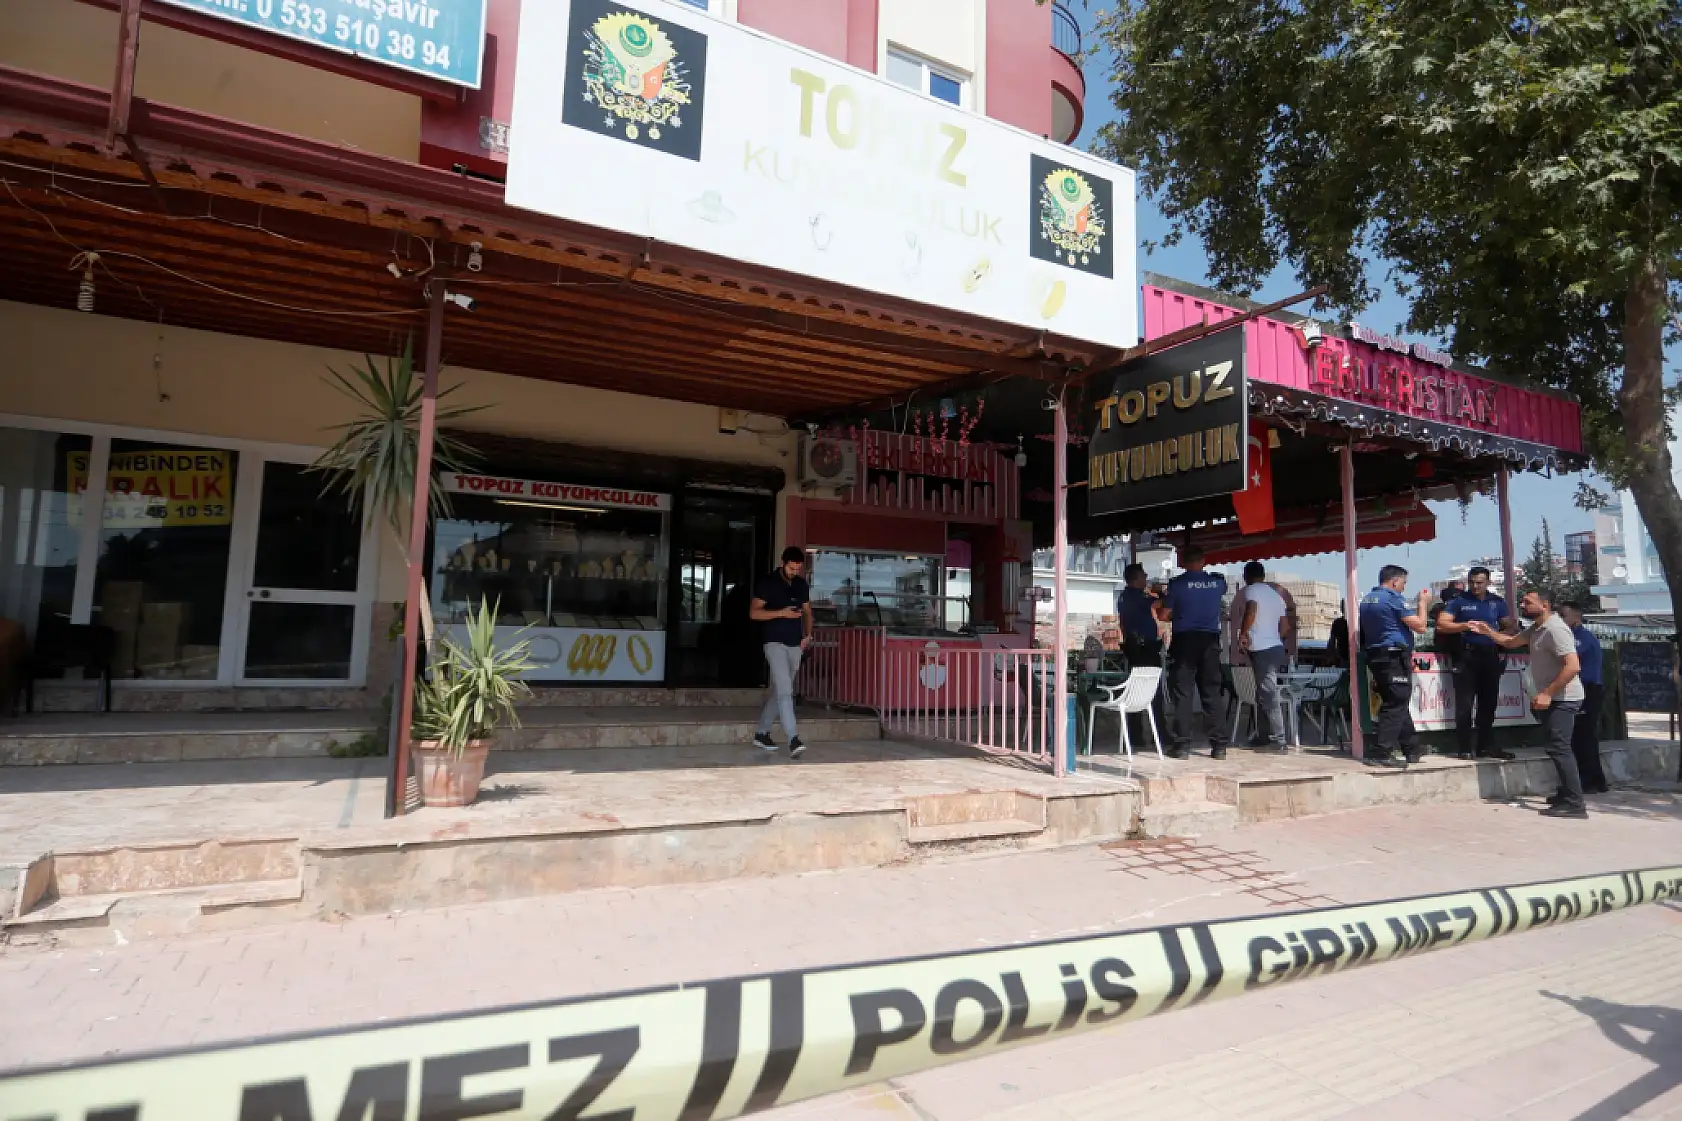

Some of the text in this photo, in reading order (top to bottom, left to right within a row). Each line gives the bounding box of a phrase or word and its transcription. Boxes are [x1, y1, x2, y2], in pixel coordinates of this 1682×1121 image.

[346, 0, 440, 28] şavir
[280, 0, 327, 35] 533
[335, 15, 380, 50] 510
[387, 30, 414, 60] 38
[422, 40, 450, 69] 94
[1094, 360, 1235, 431] TOPUZ
[73, 455, 224, 472] SHİBİNDEN
[1089, 423, 1240, 490] KUYUMCULUK
[74, 475, 224, 501] KRALIK
[454, 475, 660, 507] TOPUZ KUYUMCULUK
